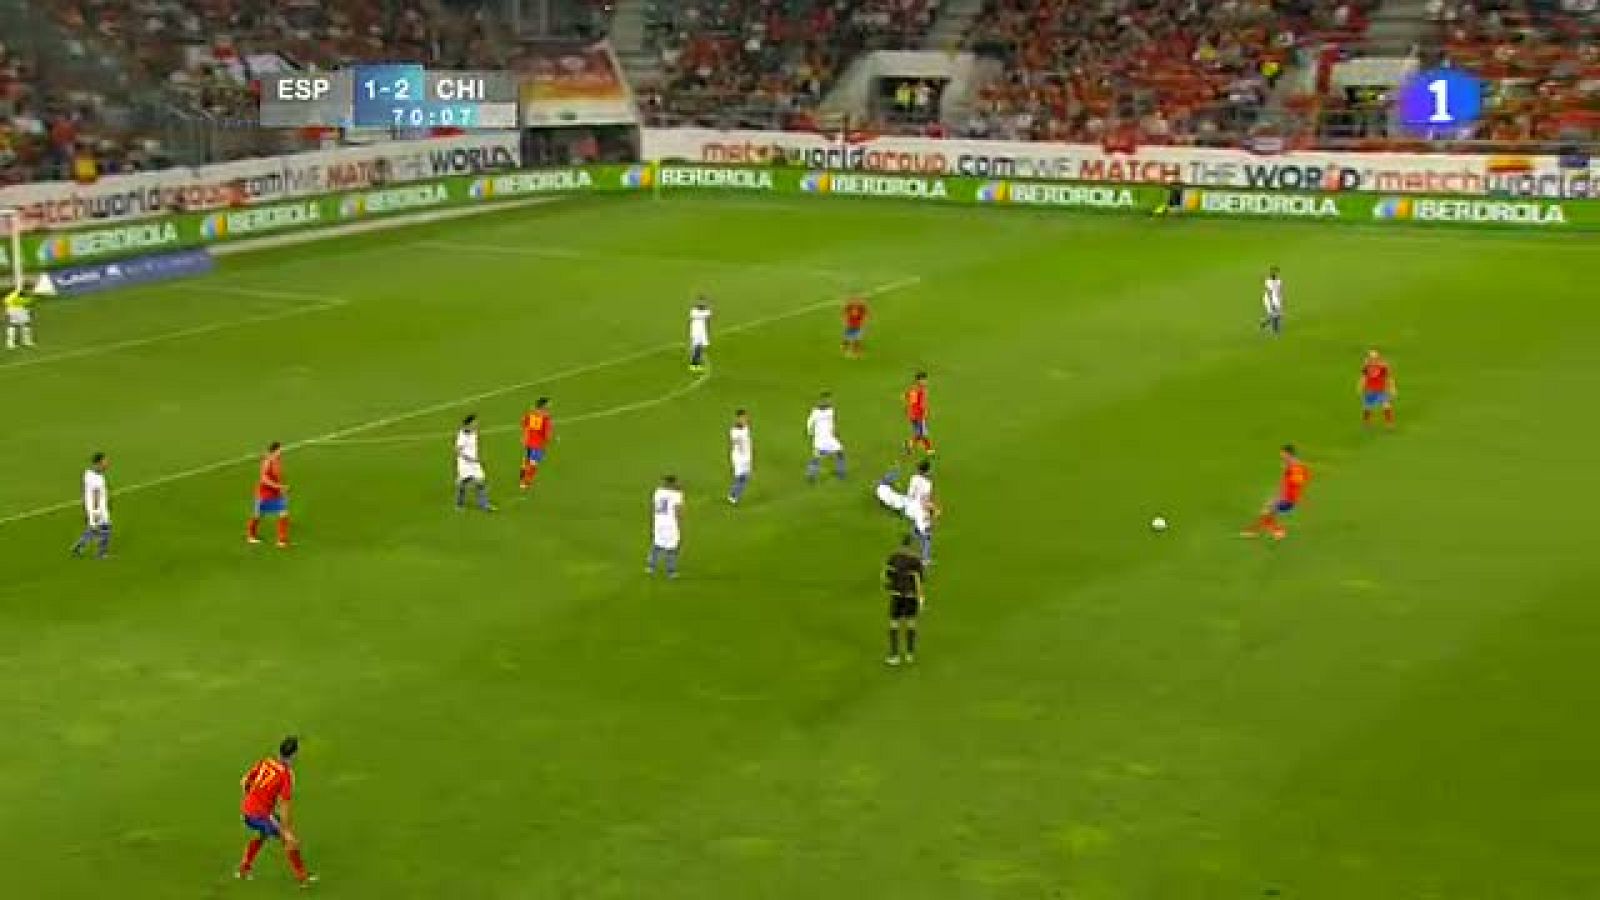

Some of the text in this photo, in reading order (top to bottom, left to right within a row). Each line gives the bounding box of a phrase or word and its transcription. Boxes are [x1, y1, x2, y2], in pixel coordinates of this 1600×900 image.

[500, 169, 592, 196] IBERDROLA
[661, 167, 773, 189] IBERDROLA
[1079, 158, 1180, 183] MATCH
[1190, 161, 1236, 185] THE
[367, 183, 447, 212] IBERDROLA
[831, 174, 947, 197] IBERDROLA
[1012, 183, 1134, 207] IBERDROLA
[228, 200, 320, 233] IBERDROLA
[1202, 190, 1340, 218] IBERDROLA
[1413, 198, 1566, 223] IBERDROLA
[71, 221, 178, 256] IBERDROLA
[253, 762, 277, 788] 17
